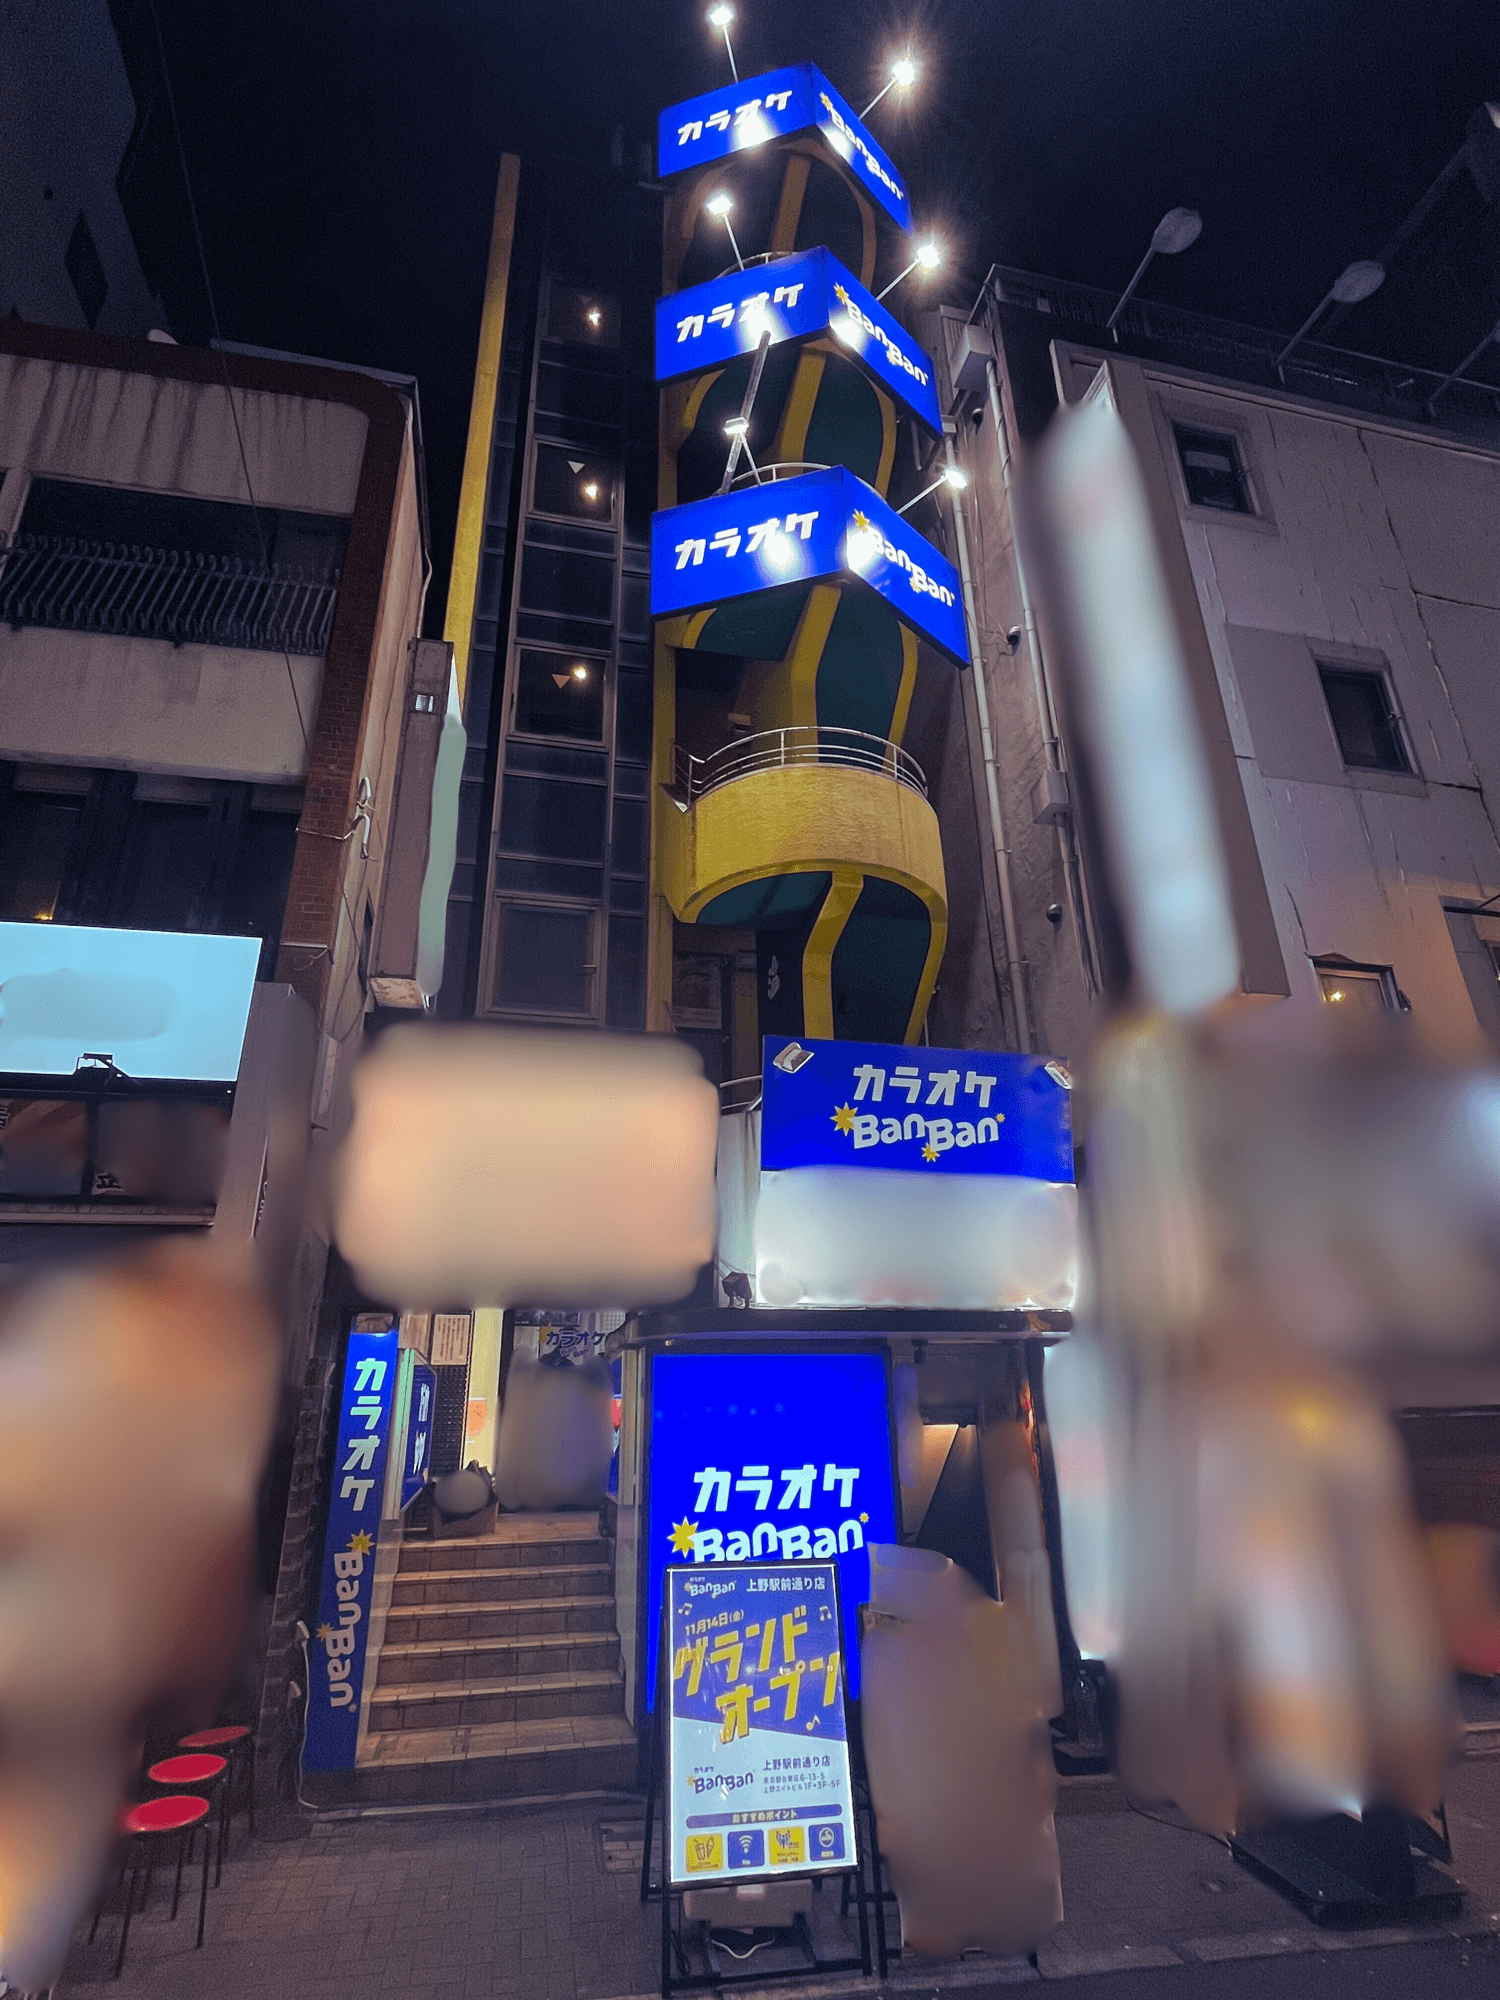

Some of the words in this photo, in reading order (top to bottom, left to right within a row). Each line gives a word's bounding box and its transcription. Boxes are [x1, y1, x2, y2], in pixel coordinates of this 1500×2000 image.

[677, 90, 793, 146] カラオケ
[829, 107, 904, 201] BanBan
[676, 282, 804, 343] カラオケ
[846, 301, 928, 387] BanBan
[675, 510, 819, 571] カラオケ
[866, 526, 953, 608] BanBan
[852, 1064, 997, 1108] カラオケ
[850, 1112, 1000, 1151] BanBan
[546, 1331, 606, 1347] カラオケ
[339, 1356, 387, 1512] カラオケ
[693, 1463, 860, 1513] カラオケ
[691, 1519, 865, 1562] BanBan
[690, 1581, 736, 1597] BanBan
[746, 1576, 826, 1592] 上野駅前通り店
[325, 1551, 365, 1709] BanBan
[673, 1604, 809, 1697] グランド
[715, 1650, 840, 1745] オープン
[694, 1772, 754, 1794] BanBan
[763, 1754, 831, 1771] 上野駅前通り店
[731, 1808, 798, 1824] おすすめポイント
